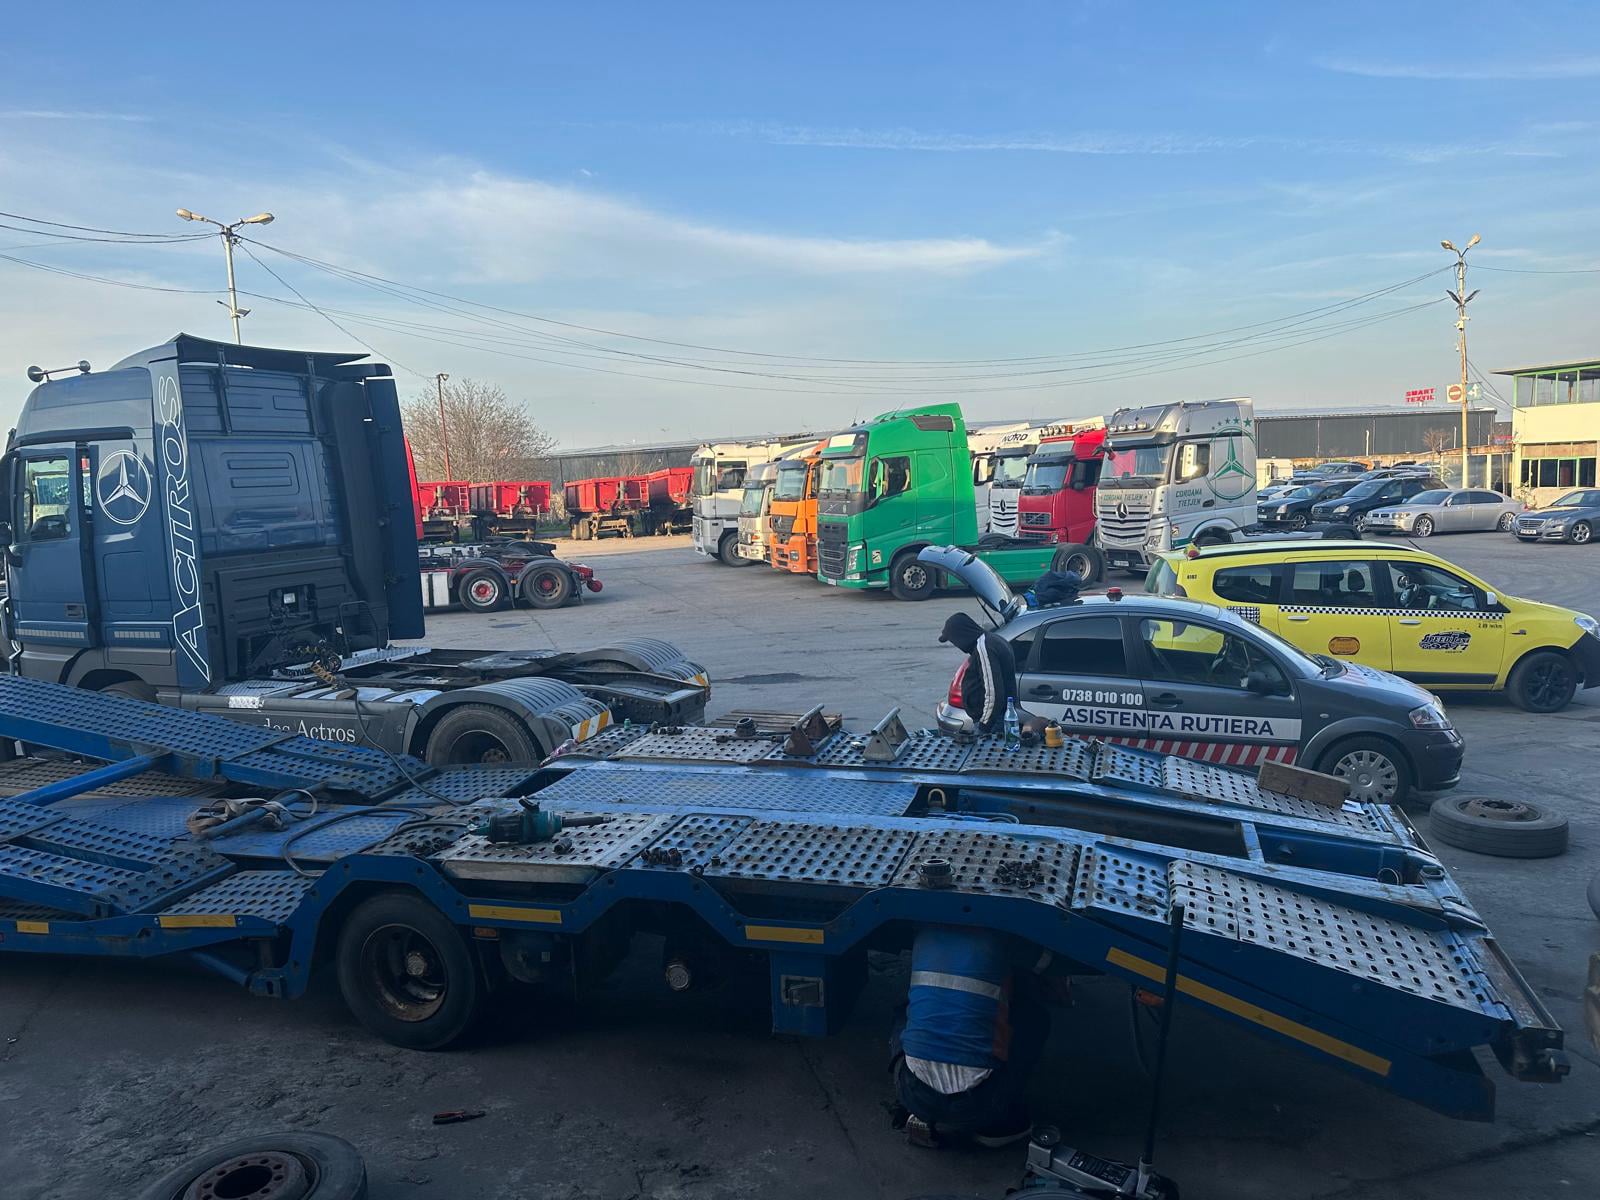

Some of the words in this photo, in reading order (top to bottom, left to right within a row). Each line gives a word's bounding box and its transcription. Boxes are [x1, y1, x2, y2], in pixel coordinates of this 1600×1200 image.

[1405, 388, 1434, 397] SMART
[1405, 394, 1434, 402] TEXTIL
[1062, 688, 1092, 702] 0738
[1095, 691, 1118, 704] 010
[1119, 693, 1143, 706] 100
[297, 719, 356, 742] Actros
[1061, 707, 1175, 730] ASISTENTA
[1180, 715, 1275, 736] RUTIERA
